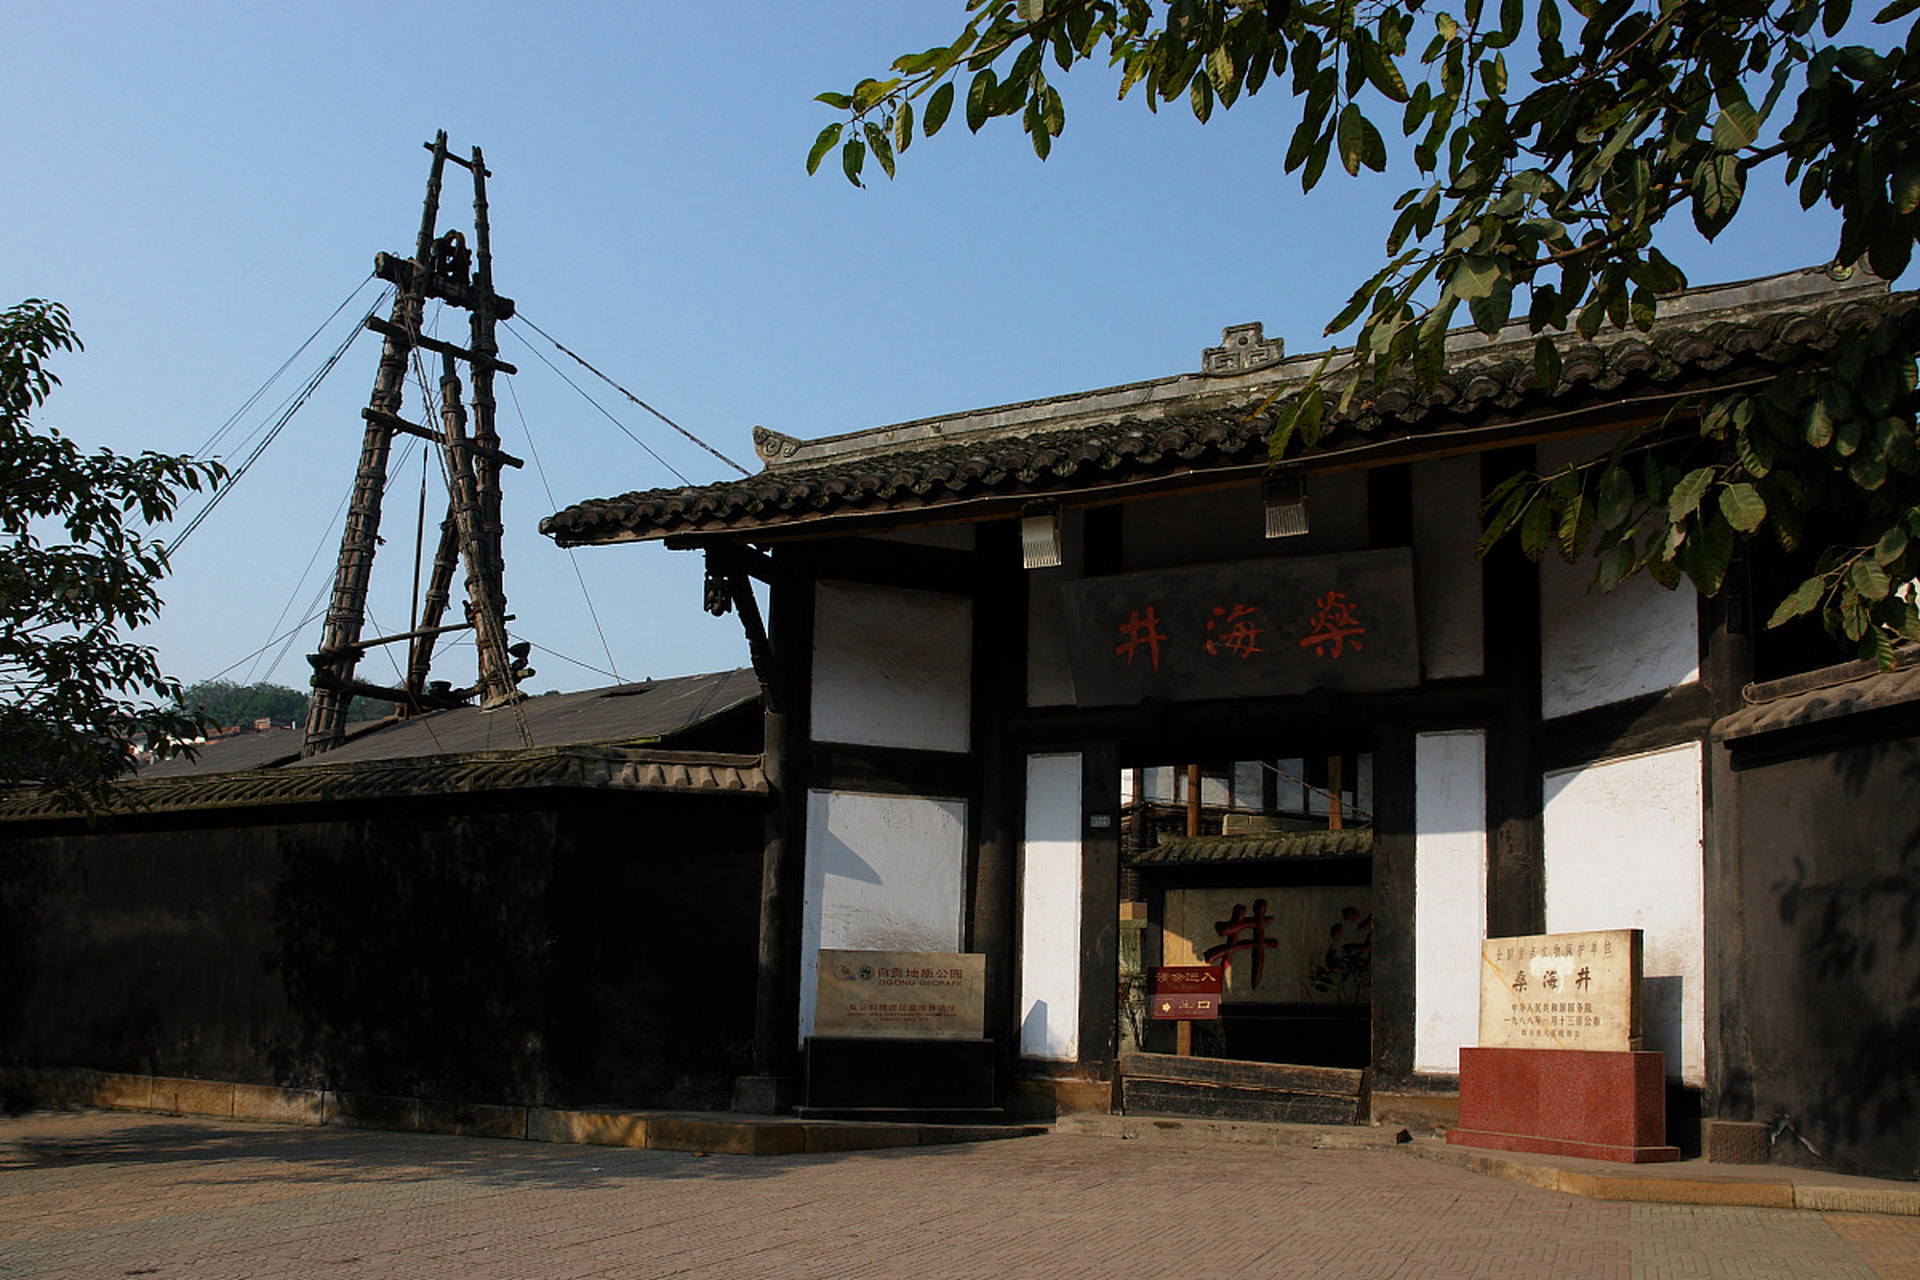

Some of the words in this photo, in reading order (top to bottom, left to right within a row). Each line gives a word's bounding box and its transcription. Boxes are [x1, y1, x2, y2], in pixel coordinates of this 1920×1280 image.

[877, 967, 963, 979] 自贡地质公园
[878, 979, 917, 987] ZIGONG
[1178, 1000, 1211, 1009] 出口
[1511, 1002, 1593, 1014] 中华人民共和国国务院
[1503, 1015, 1601, 1027] 一九八八年一月十三日公布
